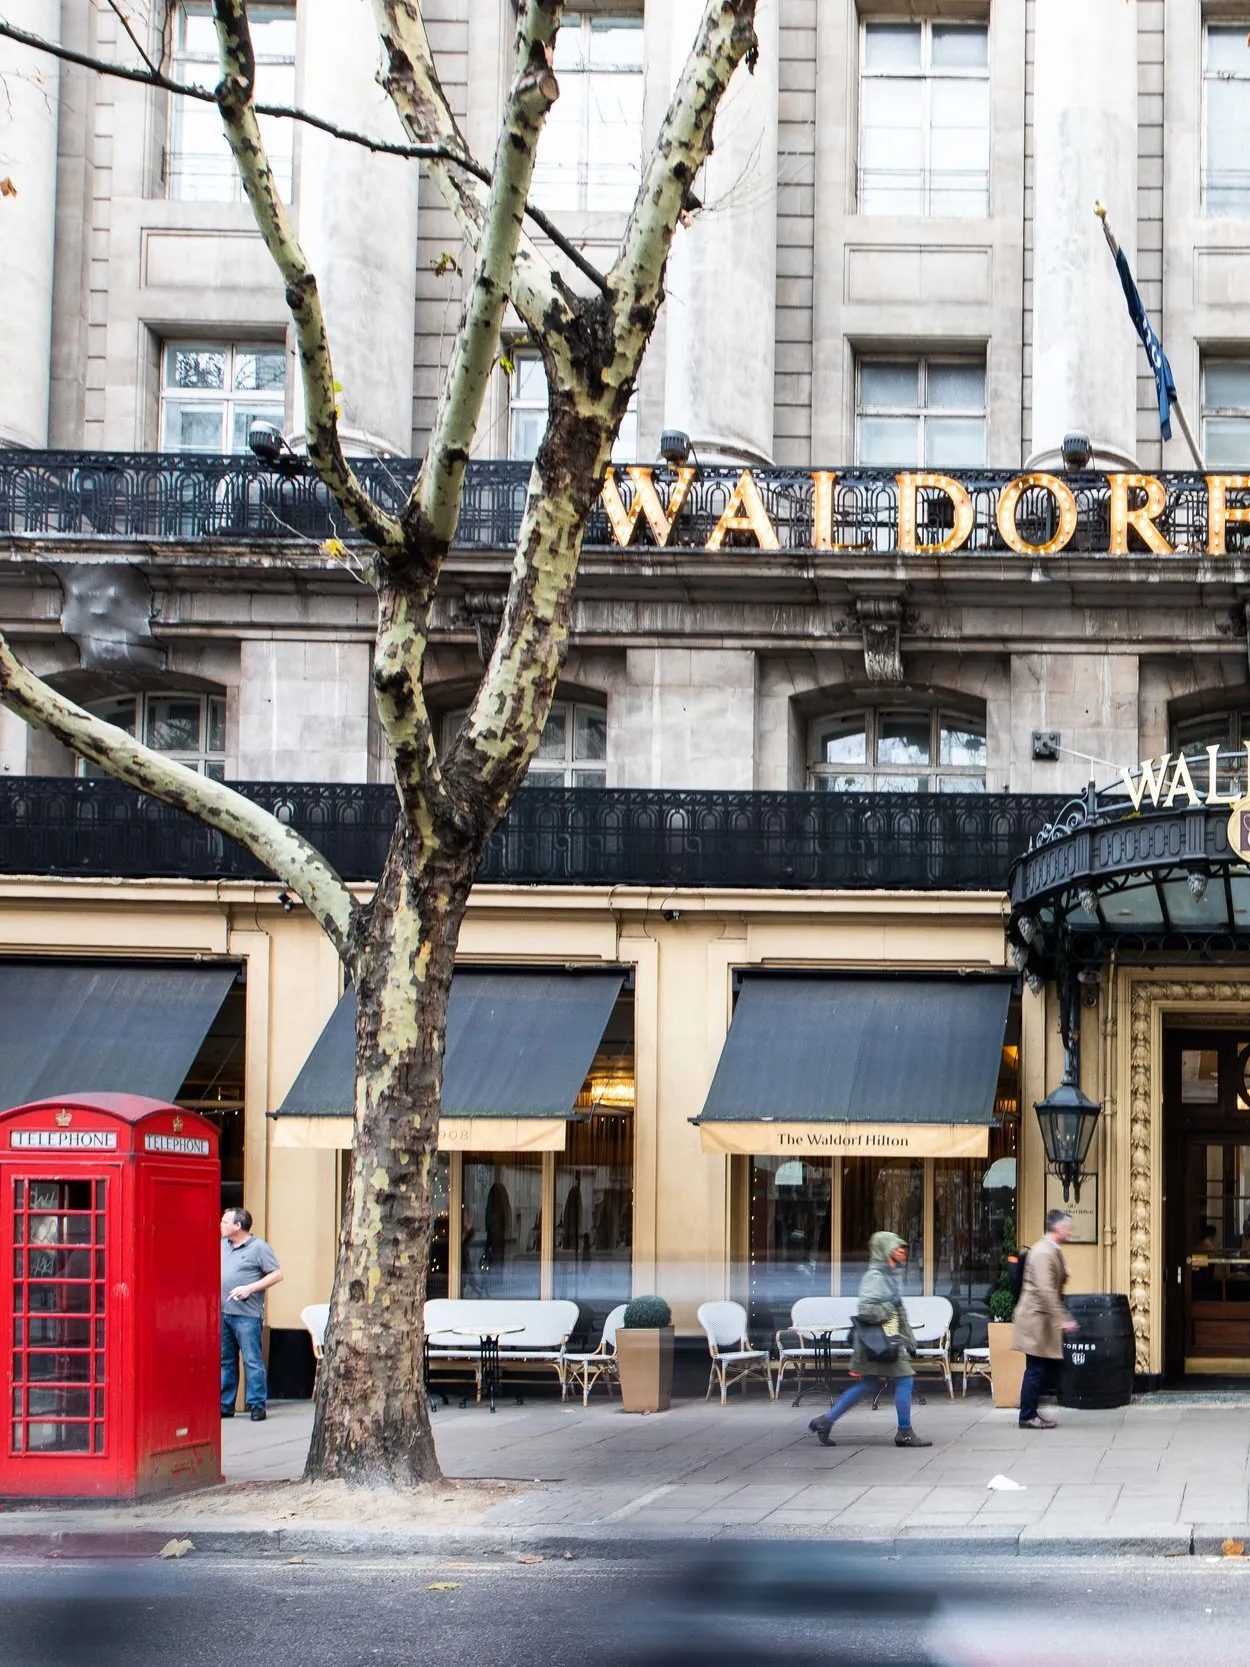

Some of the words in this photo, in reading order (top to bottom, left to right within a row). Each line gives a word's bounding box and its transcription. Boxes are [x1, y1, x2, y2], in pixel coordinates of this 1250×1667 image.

[16, 1132, 114, 1147] TELEPHONE
[145, 1134, 208, 1153] TELEPHONE
[777, 1133, 803, 1145] The
[807, 1134, 862, 1146] Waldorf
[865, 1134, 909, 1147] Hilton
